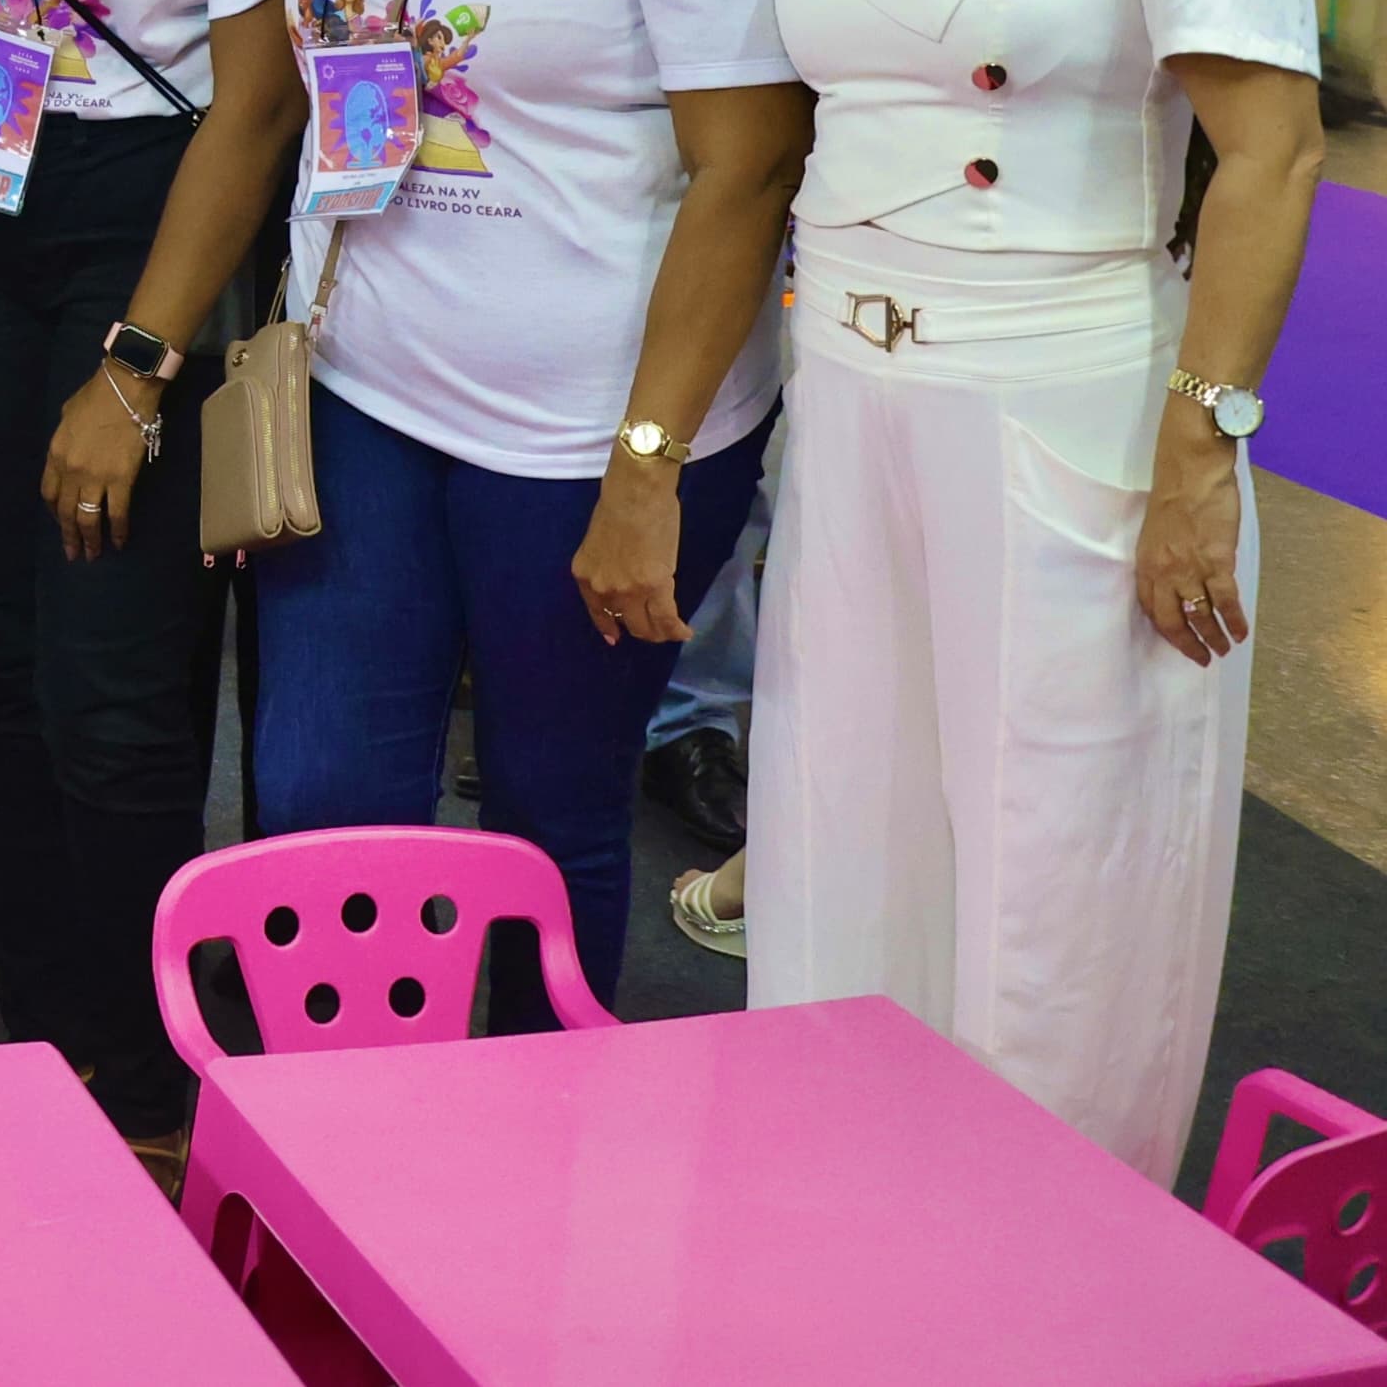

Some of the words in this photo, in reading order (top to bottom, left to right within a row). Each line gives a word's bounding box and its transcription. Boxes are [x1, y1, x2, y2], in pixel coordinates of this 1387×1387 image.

[54, 99, 72, 107] DO
[399, 182, 434, 195] ALEZA
[438, 186, 458, 197] NA
[461, 187, 481, 199] XV
[407, 197, 447, 212] LIVRO
[451, 202, 472, 214] DO
